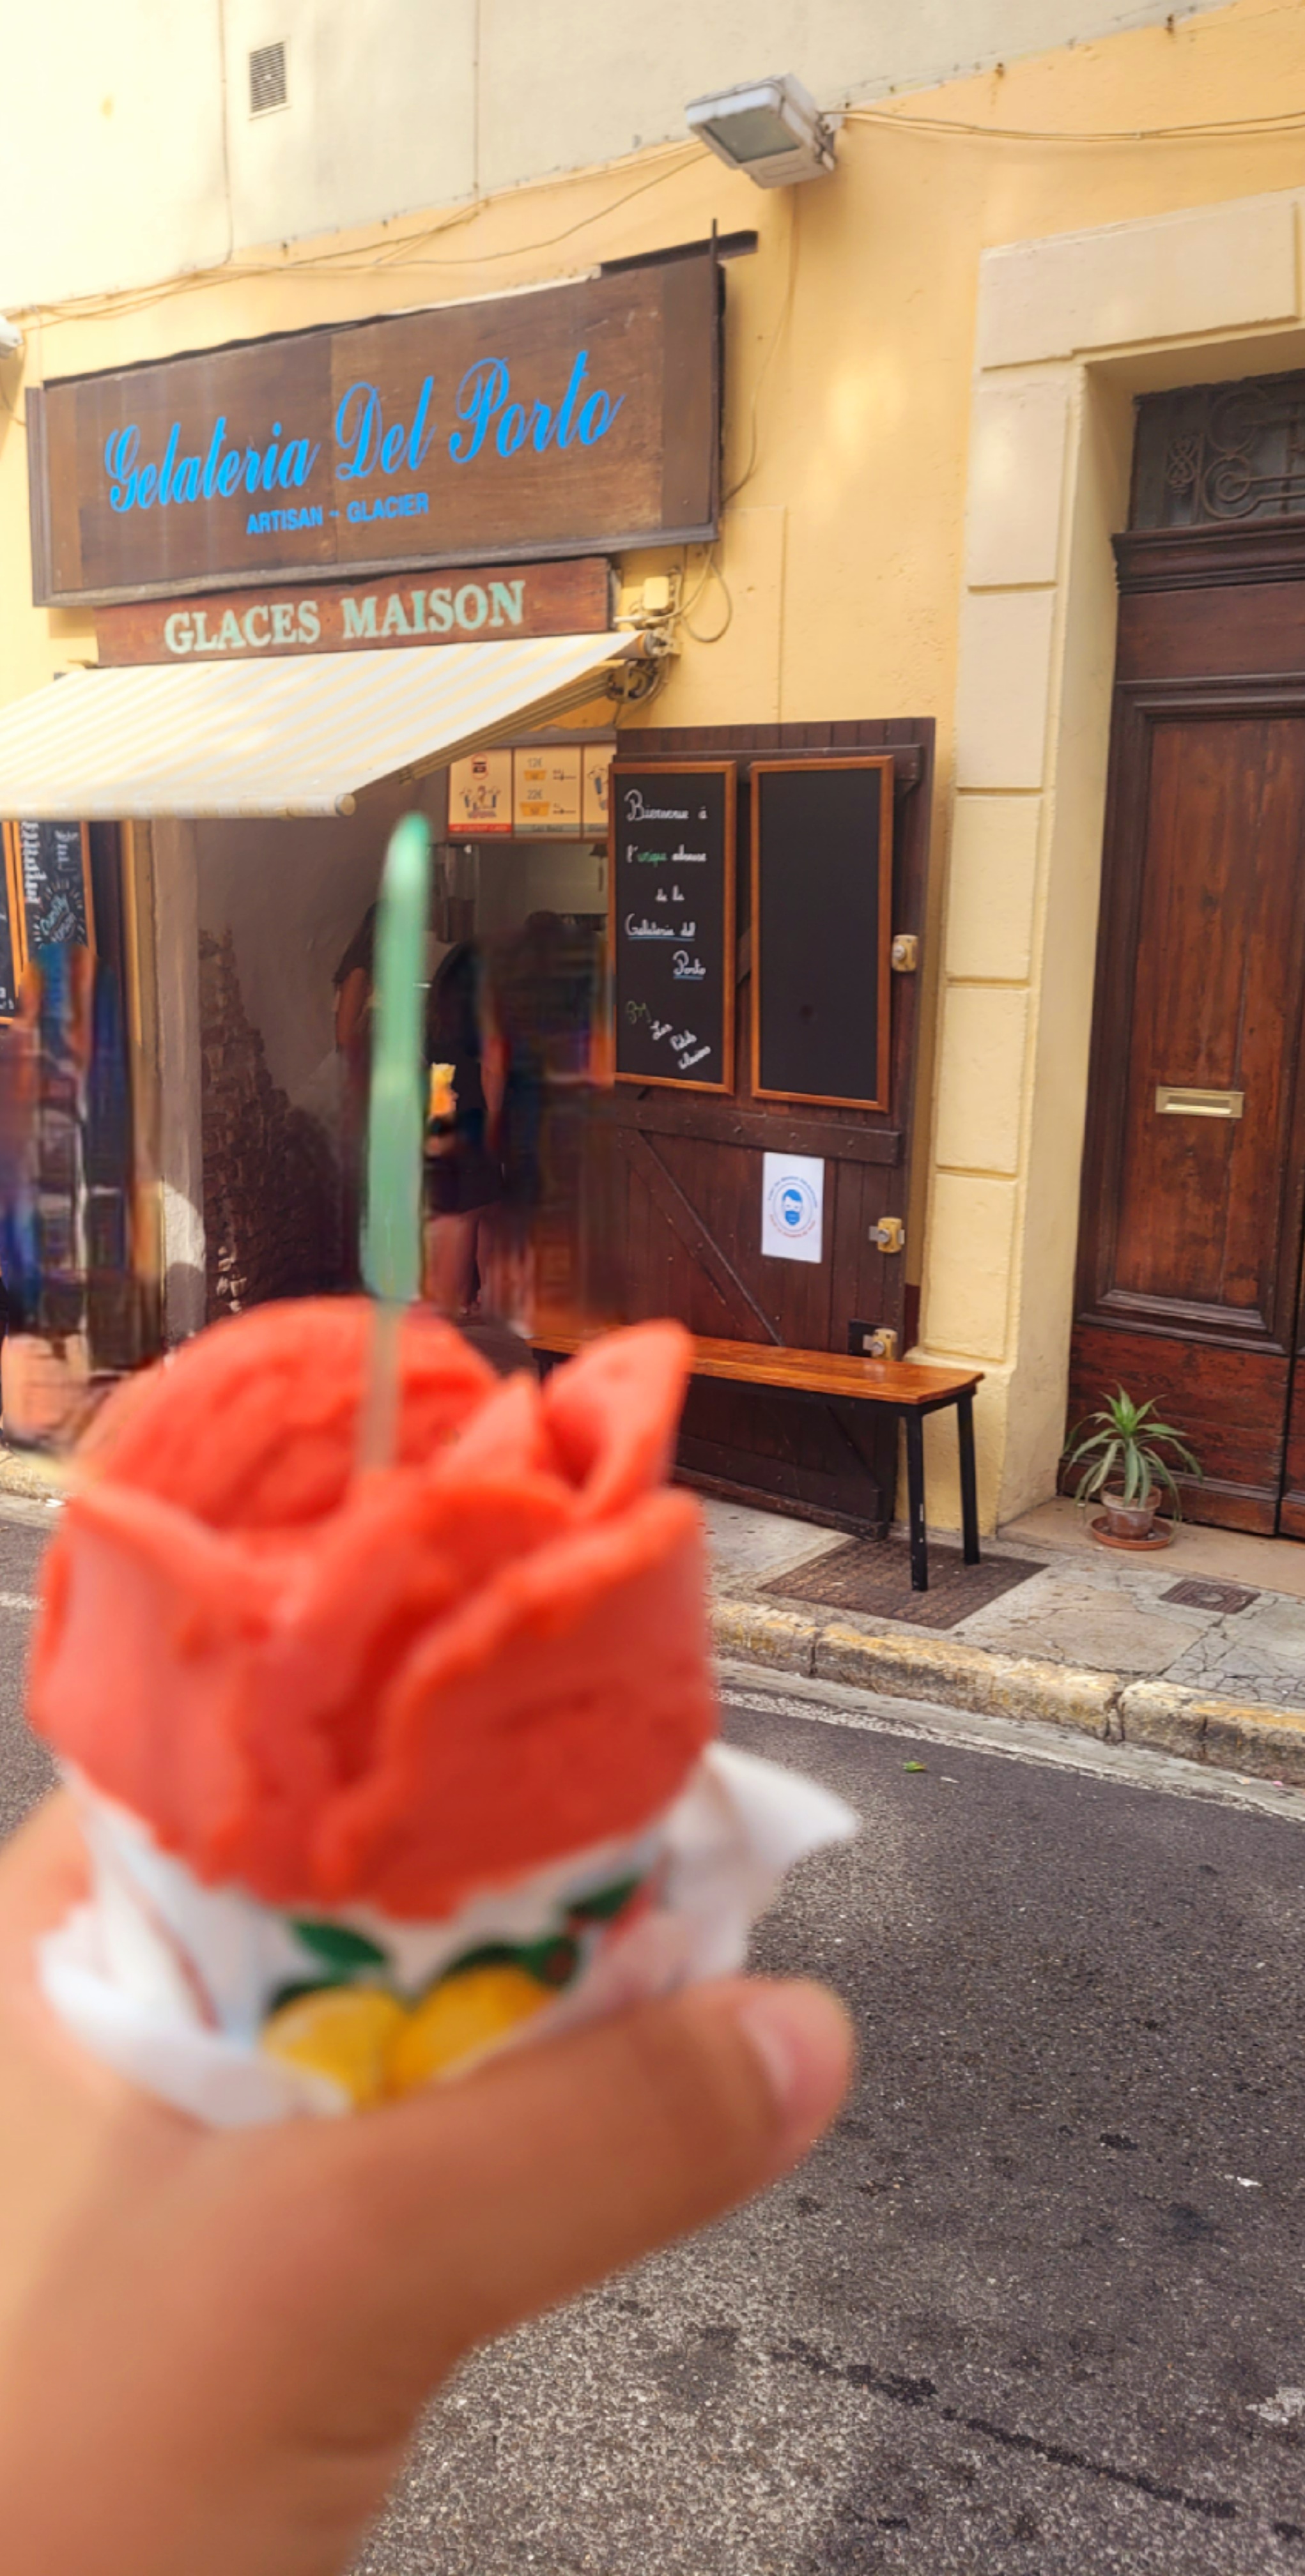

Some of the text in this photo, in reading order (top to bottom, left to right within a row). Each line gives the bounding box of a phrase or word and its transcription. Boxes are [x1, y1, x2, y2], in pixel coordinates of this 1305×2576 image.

[104, 349, 626, 513] Gelateria Del Porto
[247, 505, 323, 535] ARTISAN
[346, 492, 429, 523] GLACIER
[164, 581, 525, 654] GLACES MAISON
[672, 949, 706, 976] Porto
